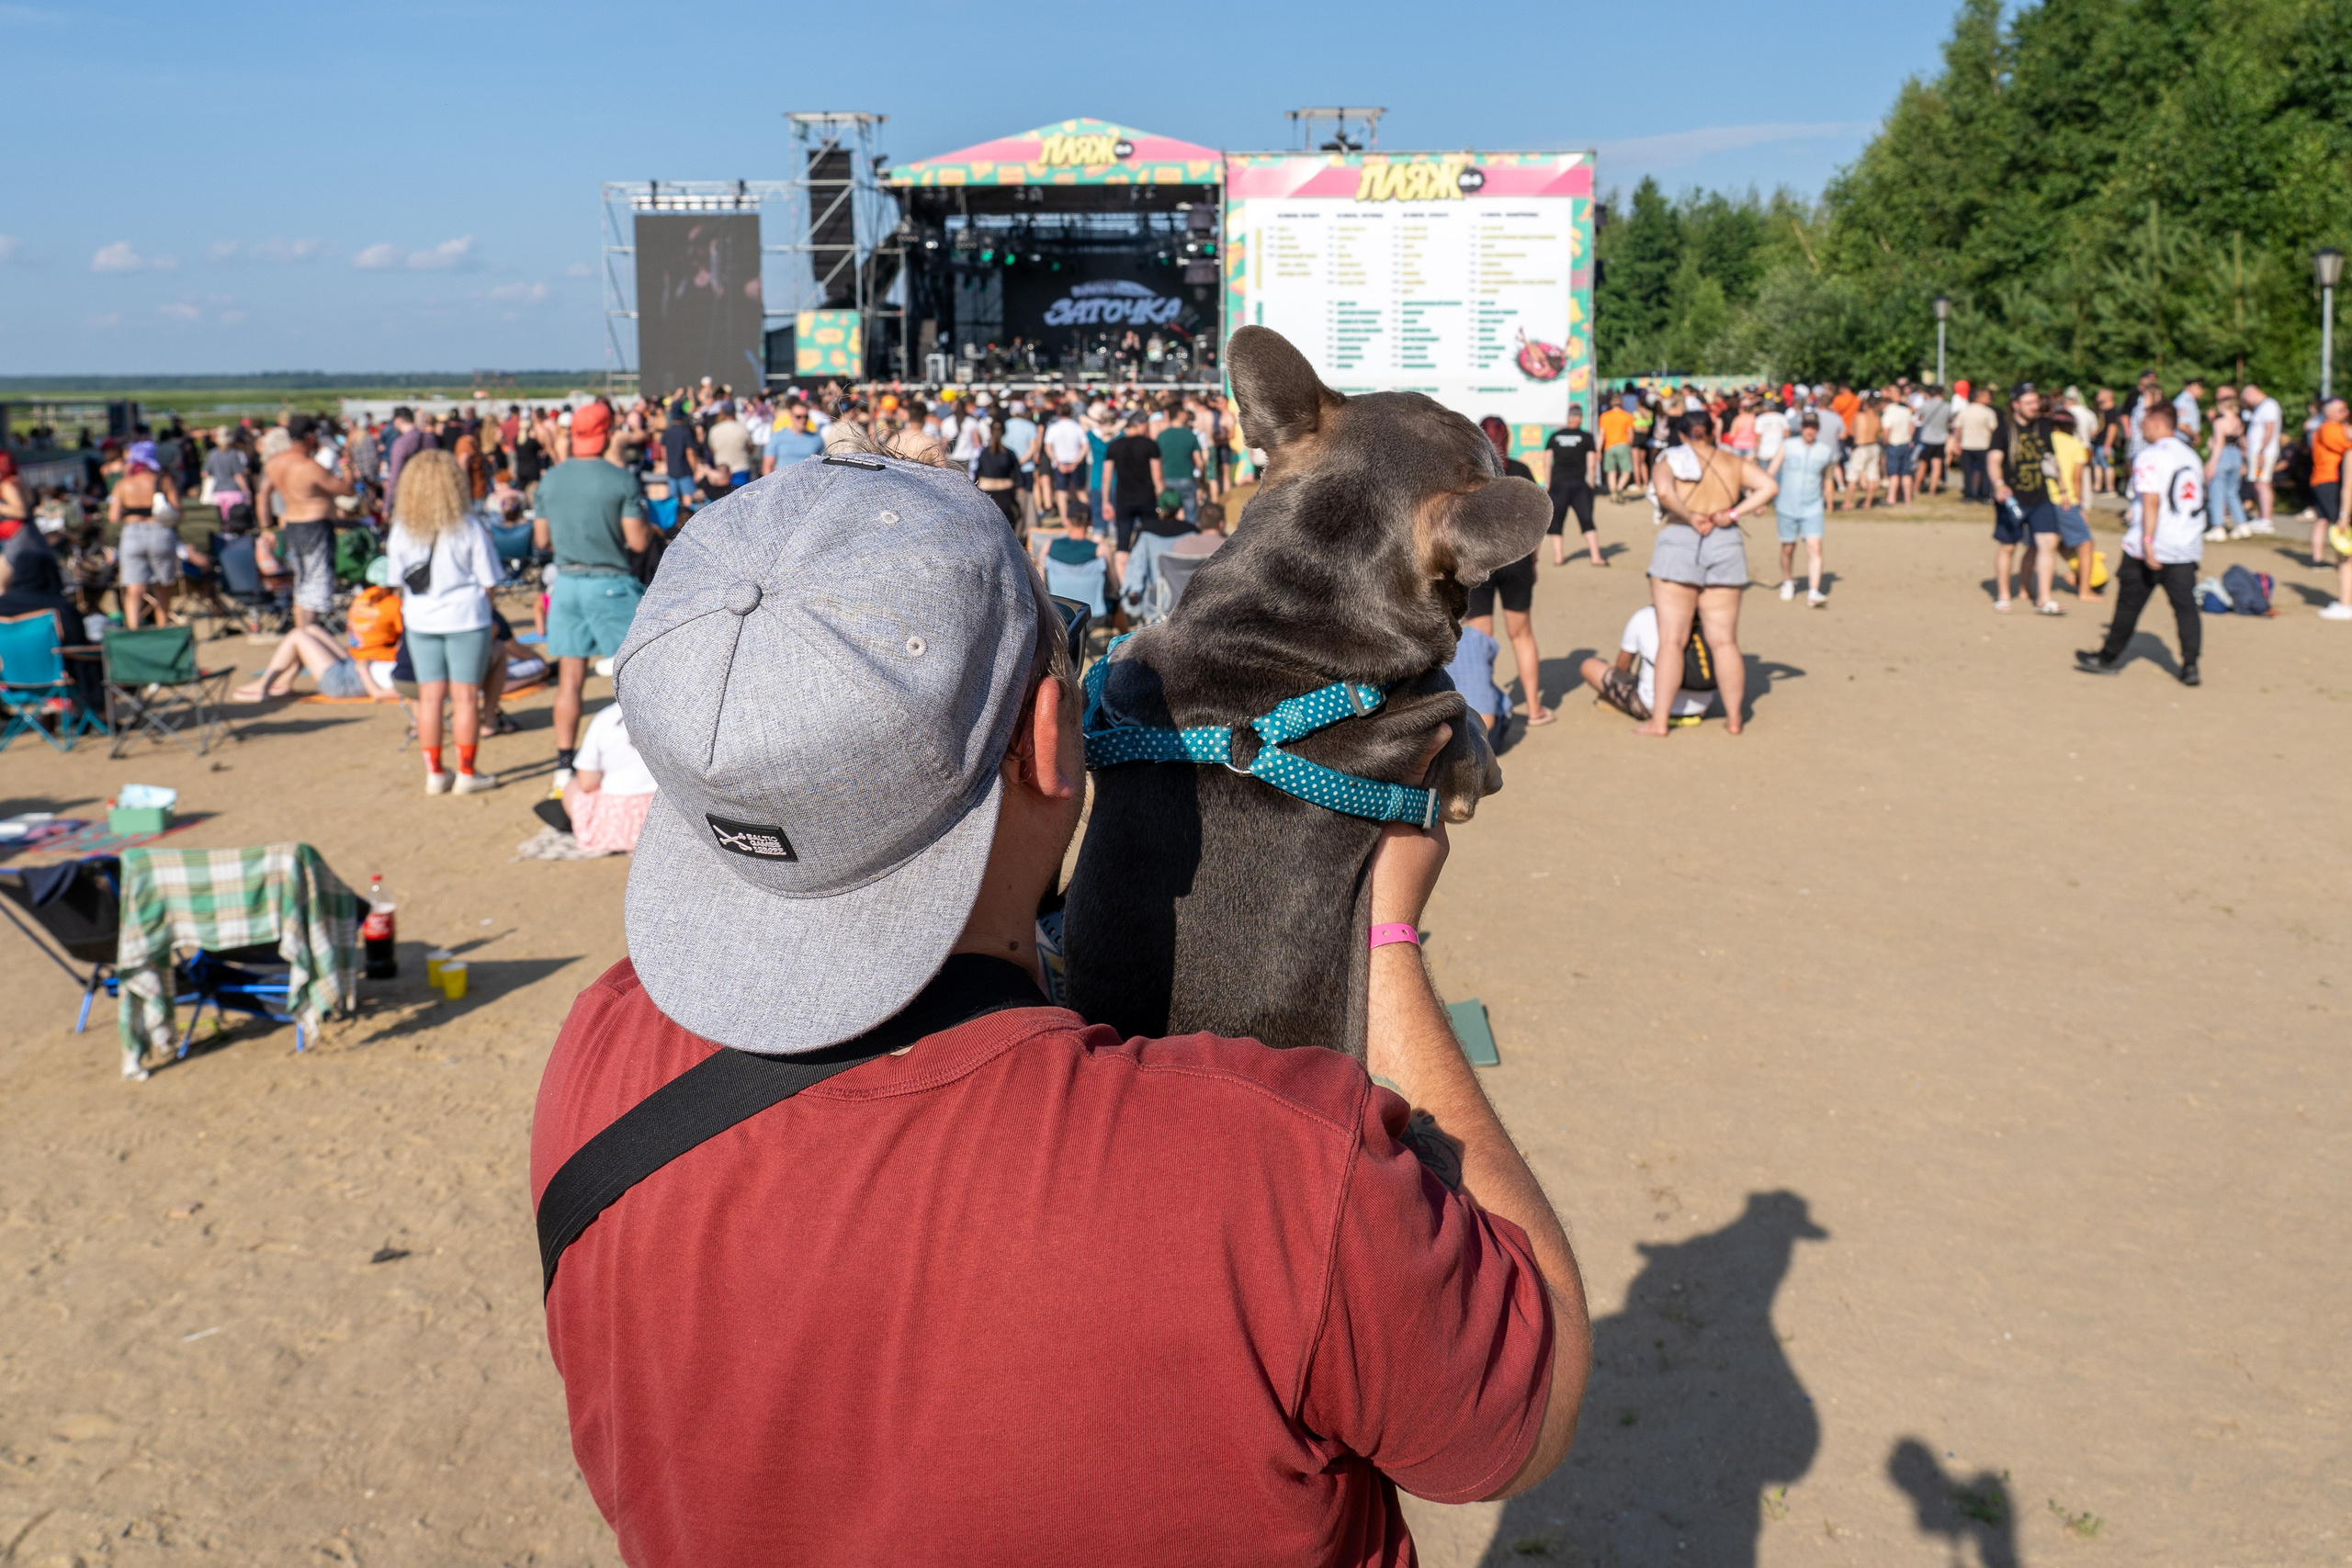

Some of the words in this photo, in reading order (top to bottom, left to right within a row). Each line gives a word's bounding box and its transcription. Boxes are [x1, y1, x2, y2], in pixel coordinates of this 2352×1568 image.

[1355, 163, 1465, 201] ПЛЯЖ
[1043, 297, 1182, 326] ЗАТОЧКА
[746, 833, 778, 842] BALTIC
